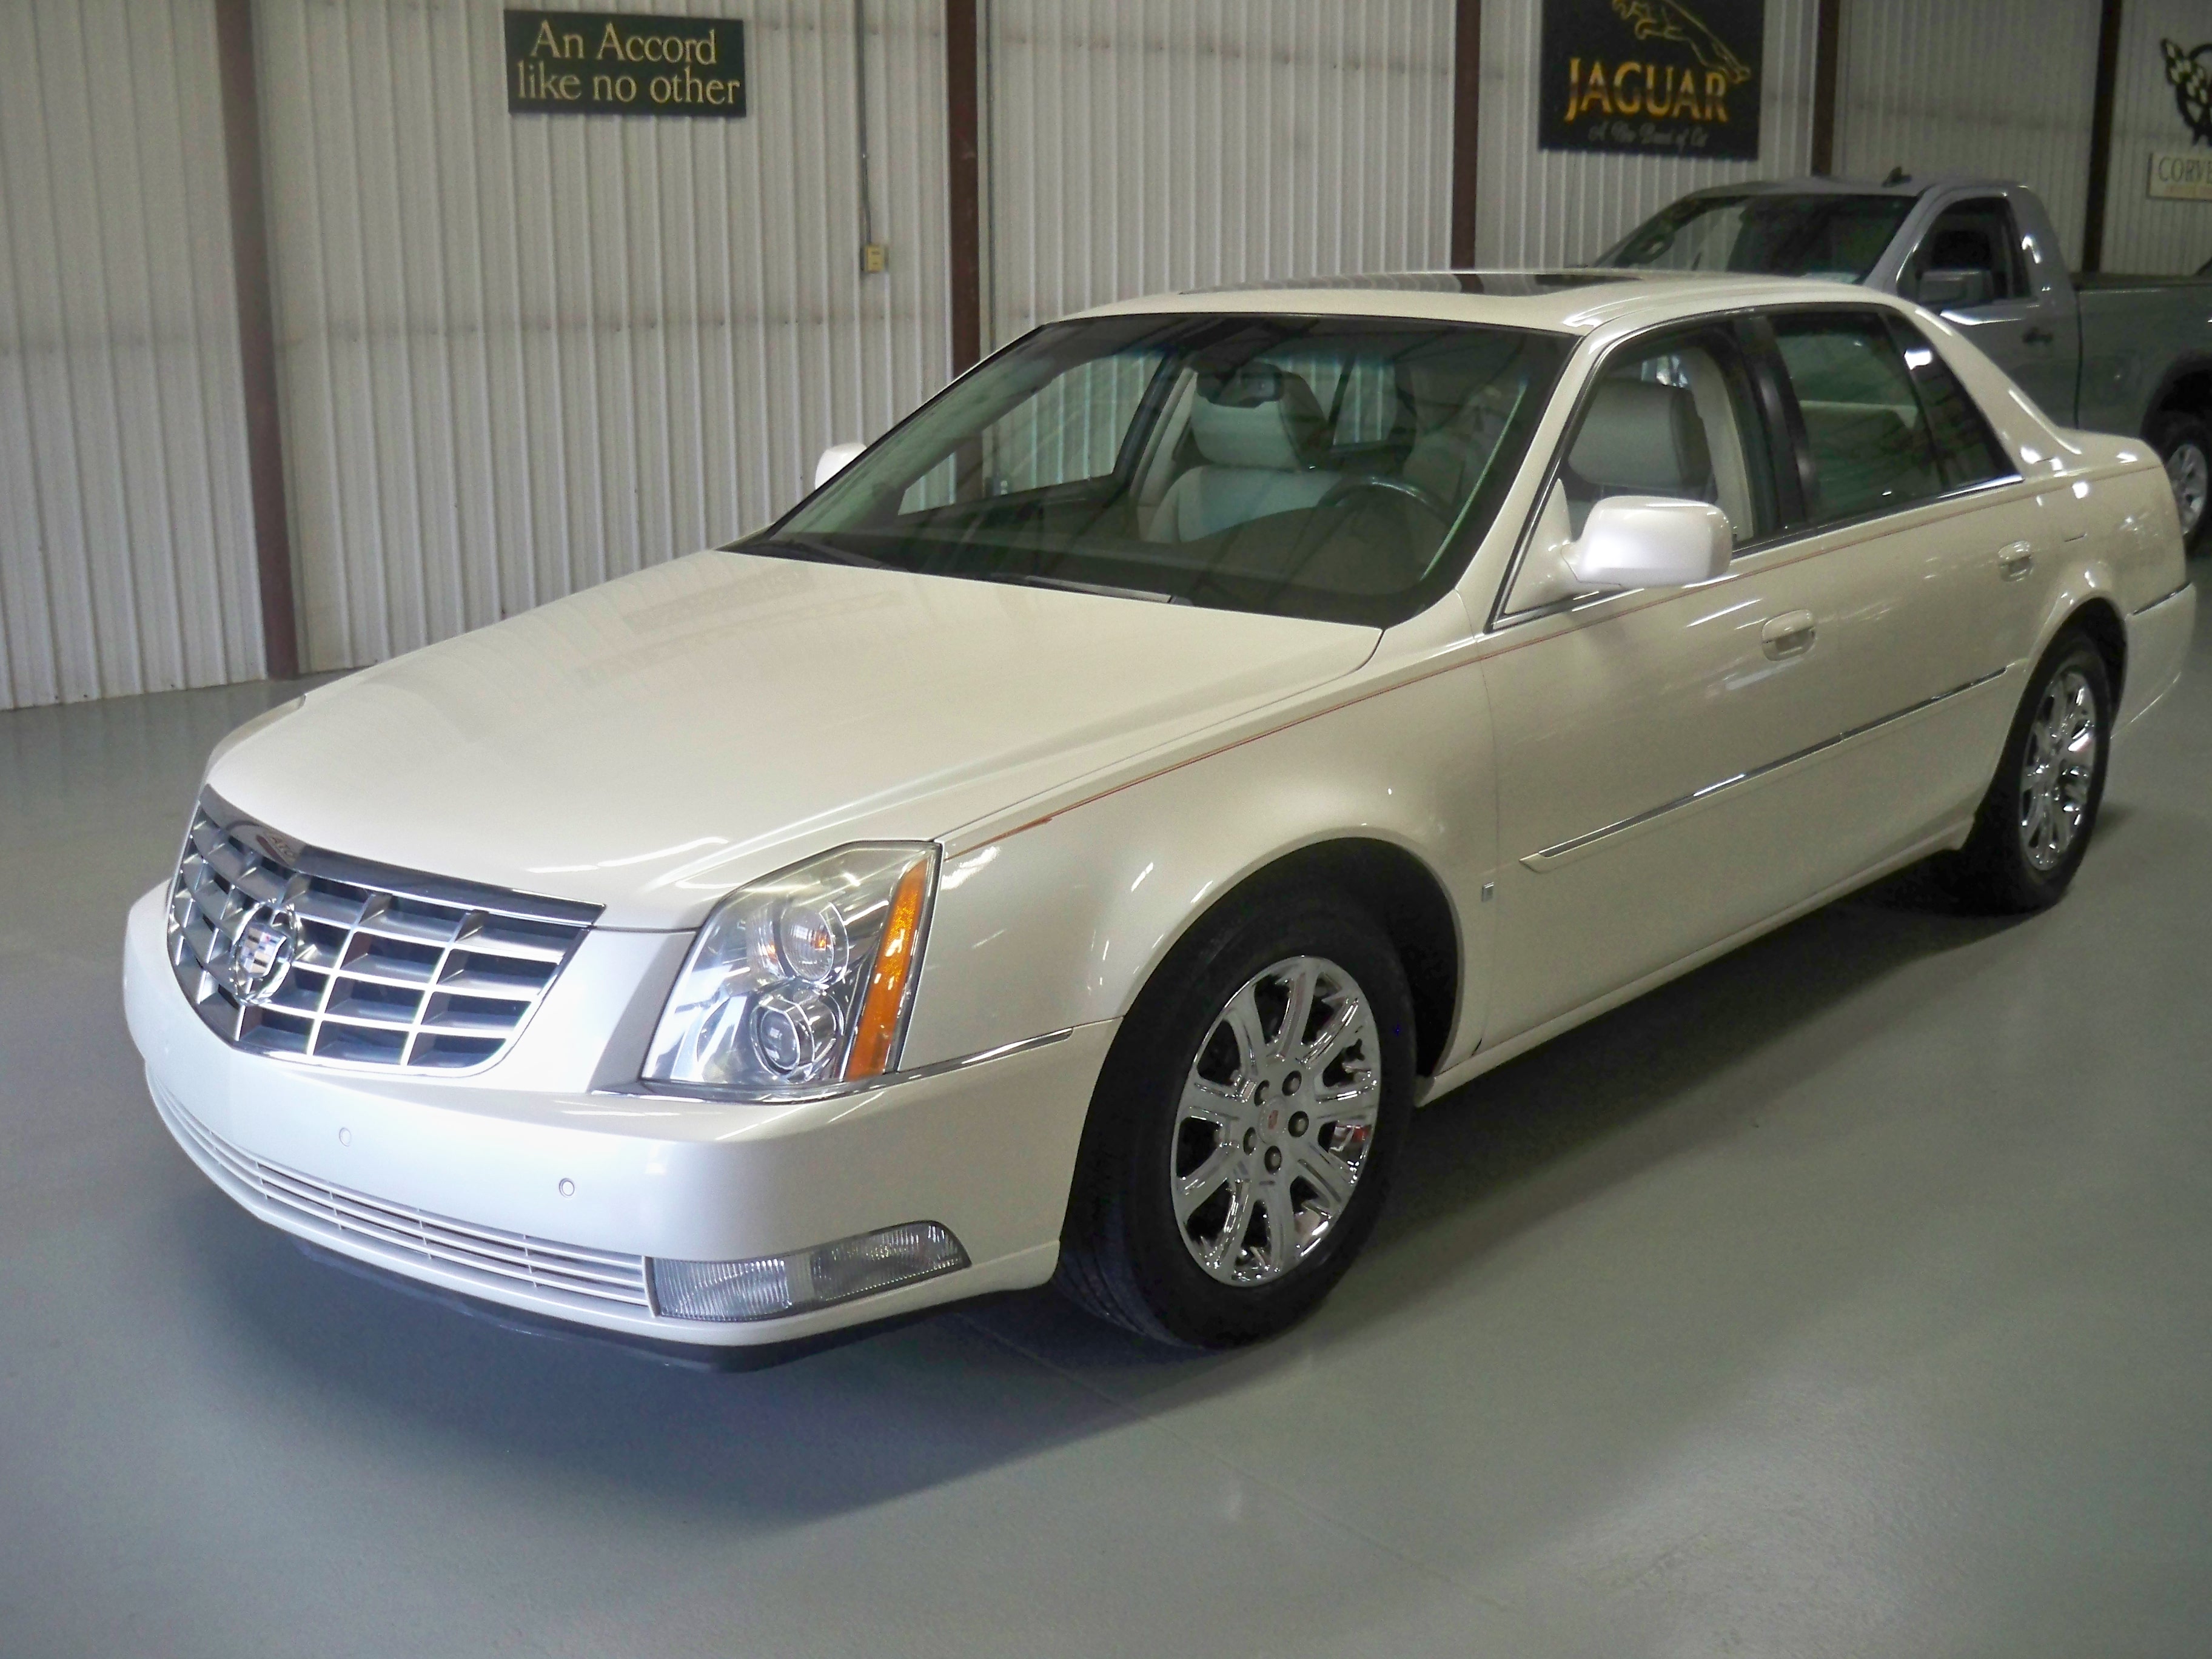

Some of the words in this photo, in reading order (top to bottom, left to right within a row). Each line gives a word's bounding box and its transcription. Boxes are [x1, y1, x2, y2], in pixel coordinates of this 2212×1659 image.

[530, 19, 585, 59] An
[597, 22, 717, 65] Accord
[517, 60, 582, 100] like
[593, 75, 637, 102] no
[649, 65, 740, 105] other
[1564, 58, 1728, 122] JAGUAR
